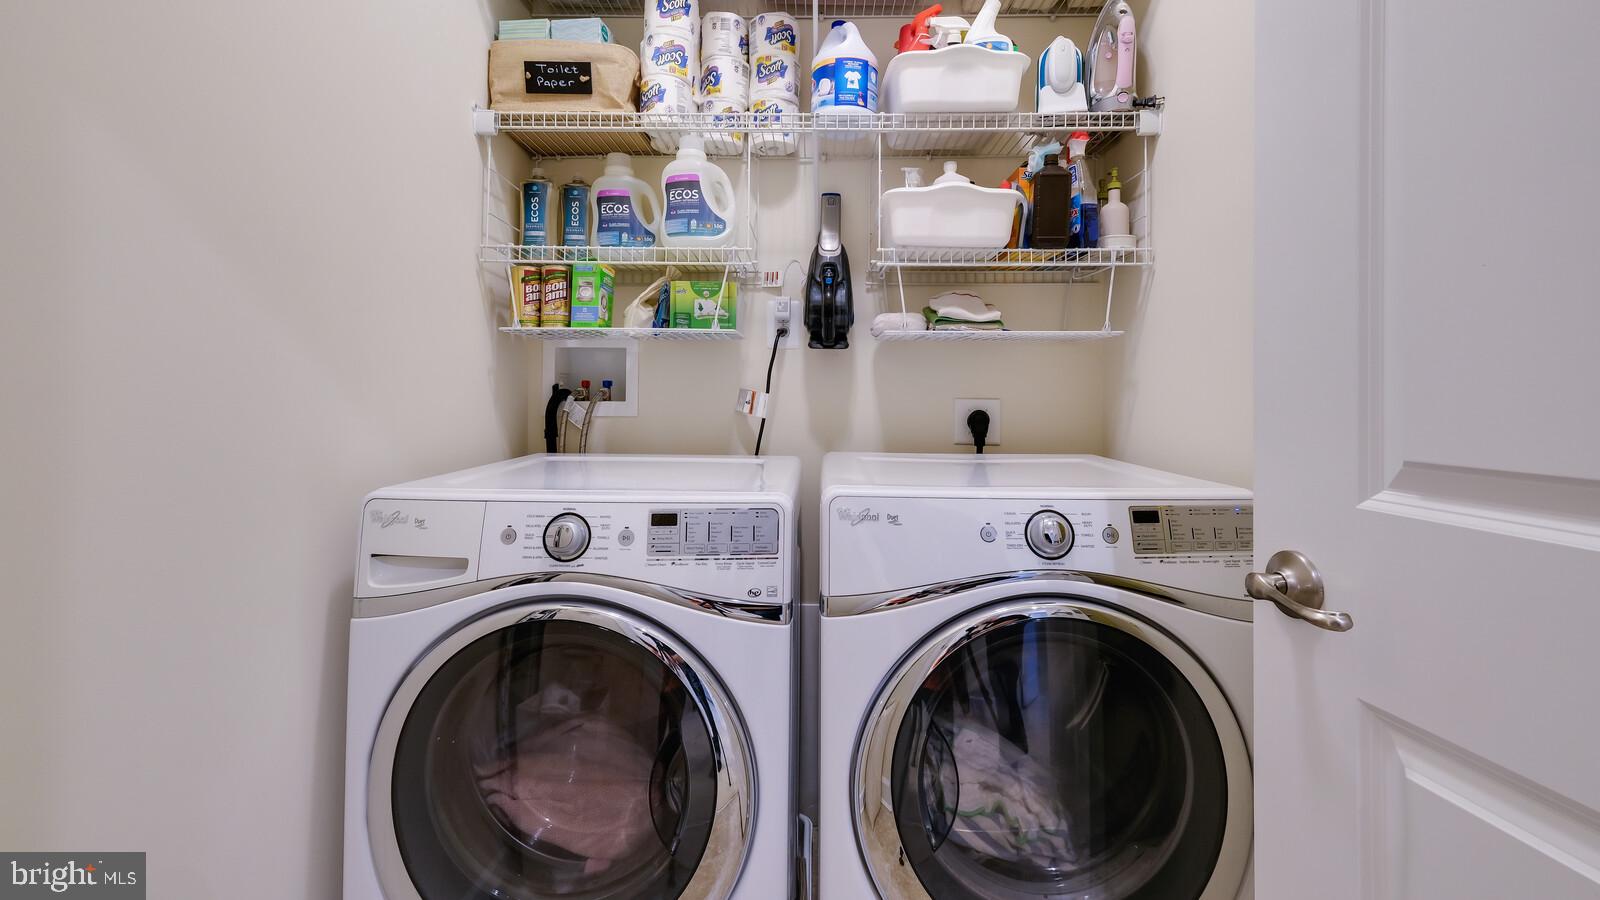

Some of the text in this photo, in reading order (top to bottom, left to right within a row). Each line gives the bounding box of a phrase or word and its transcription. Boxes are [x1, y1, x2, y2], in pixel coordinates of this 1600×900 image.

[769, 30, 793, 45] Scott
[656, 51, 683, 66] Scott
[535, 63, 580, 74] Toilet
[759, 60, 782, 77] Scott
[536, 76, 576, 89] Paper
[669, 189, 699, 201] ECOS
[530, 196, 539, 223] ECOS
[571, 201, 579, 226] ECOS
[601, 204, 630, 214] ECOS
